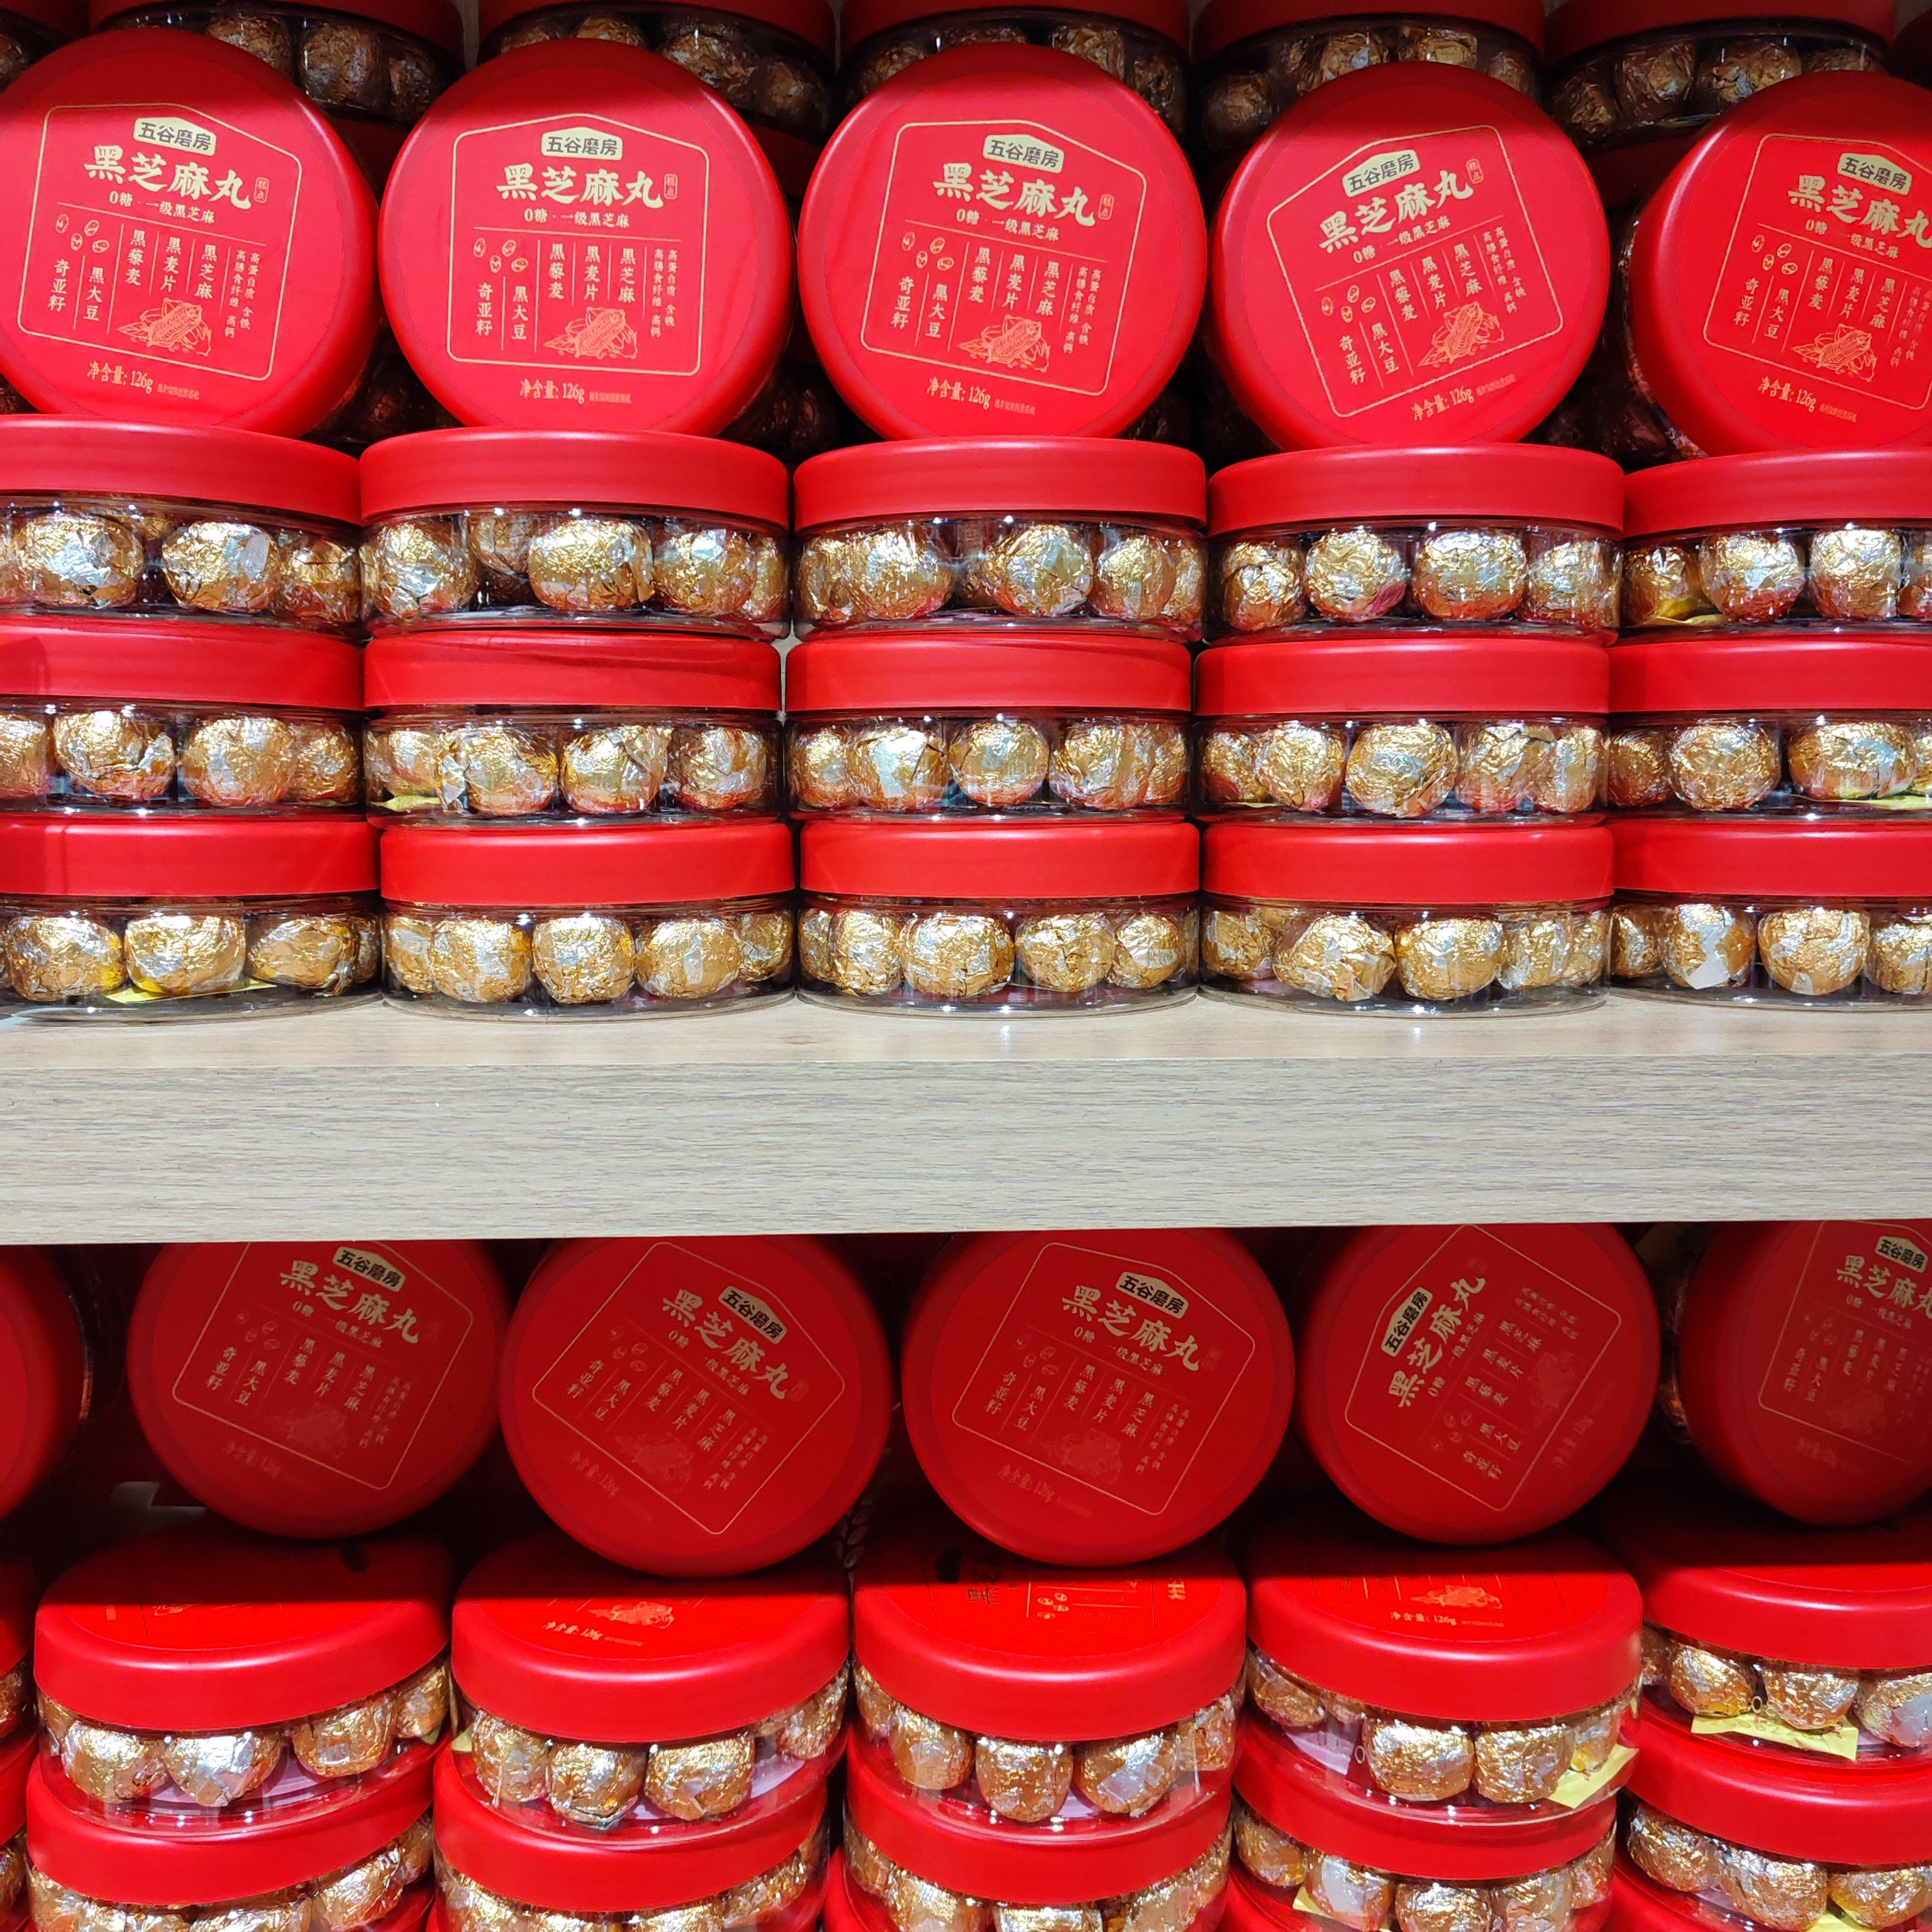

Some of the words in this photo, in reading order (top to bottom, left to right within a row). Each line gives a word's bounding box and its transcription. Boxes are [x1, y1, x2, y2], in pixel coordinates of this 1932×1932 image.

[140, 122, 211, 150] 五谷磨房
[548, 136, 617, 155] 五谷磨房
[989, 140, 1059, 167] 五谷磨房
[83, 144, 252, 210] 黑芝麻丸
[496, 162, 664, 209] 黑芝麻丸
[932, 162, 1096, 227] 黑芝麻丸
[1348, 153, 1413, 192] 五谷磨房
[1843, 157, 1907, 189] 五谷磨房
[1318, 169, 1475, 253] 黑芝麻丸
[1787, 174, 1932, 249] 黑芝麻丸
[48, 258, 70, 313] 奇亚籽
[161, 236, 182, 293] 黑麦片
[195, 243, 218, 300] 黑芝麻
[584, 245, 601, 301] 黑麦片
[618, 247, 636, 303] 黑芝麻
[1003, 253, 1026, 309] 黑麦片
[1036, 260, 1060, 316] 黑芝麻
[1421, 255, 1448, 309] 黑麦片
[1453, 242, 1484, 296] 黑芝麻
[84, 266, 105, 322] 黑大豆
[475, 282, 493, 336] 奇亚籽
[511, 286, 529, 340] 黑大豆
[891, 276, 915, 330] 奇亚籽
[926, 284, 949, 339] 黑大豆
[1732, 277, 1760, 328] 奇亚籽
[1763, 287, 1790, 340] 黑大豆
[1838, 267, 1865, 319] 黑麦片
[1868, 276, 1896, 330] 黑芝麻
[1340, 335, 1367, 385] 奇亚籽
[1372, 321, 1401, 375] 黑大豆
[338, 1250, 401, 1287] 五谷磨房
[1879, 1240, 1924, 1269] 五谷磨房
[279, 1259, 419, 1345] 黑芝麻丸
[723, 1291, 782, 1338] 五谷磨房
[1121, 1275, 1184, 1314] 五谷磨房
[1385, 1291, 1428, 1351] 五谷磨房
[661, 1288, 789, 1401] 黑芝麻丸
[1060, 1284, 1200, 1372] 黑芝麻丸
[1387, 1276, 1487, 1407] 黑芝麻丸
